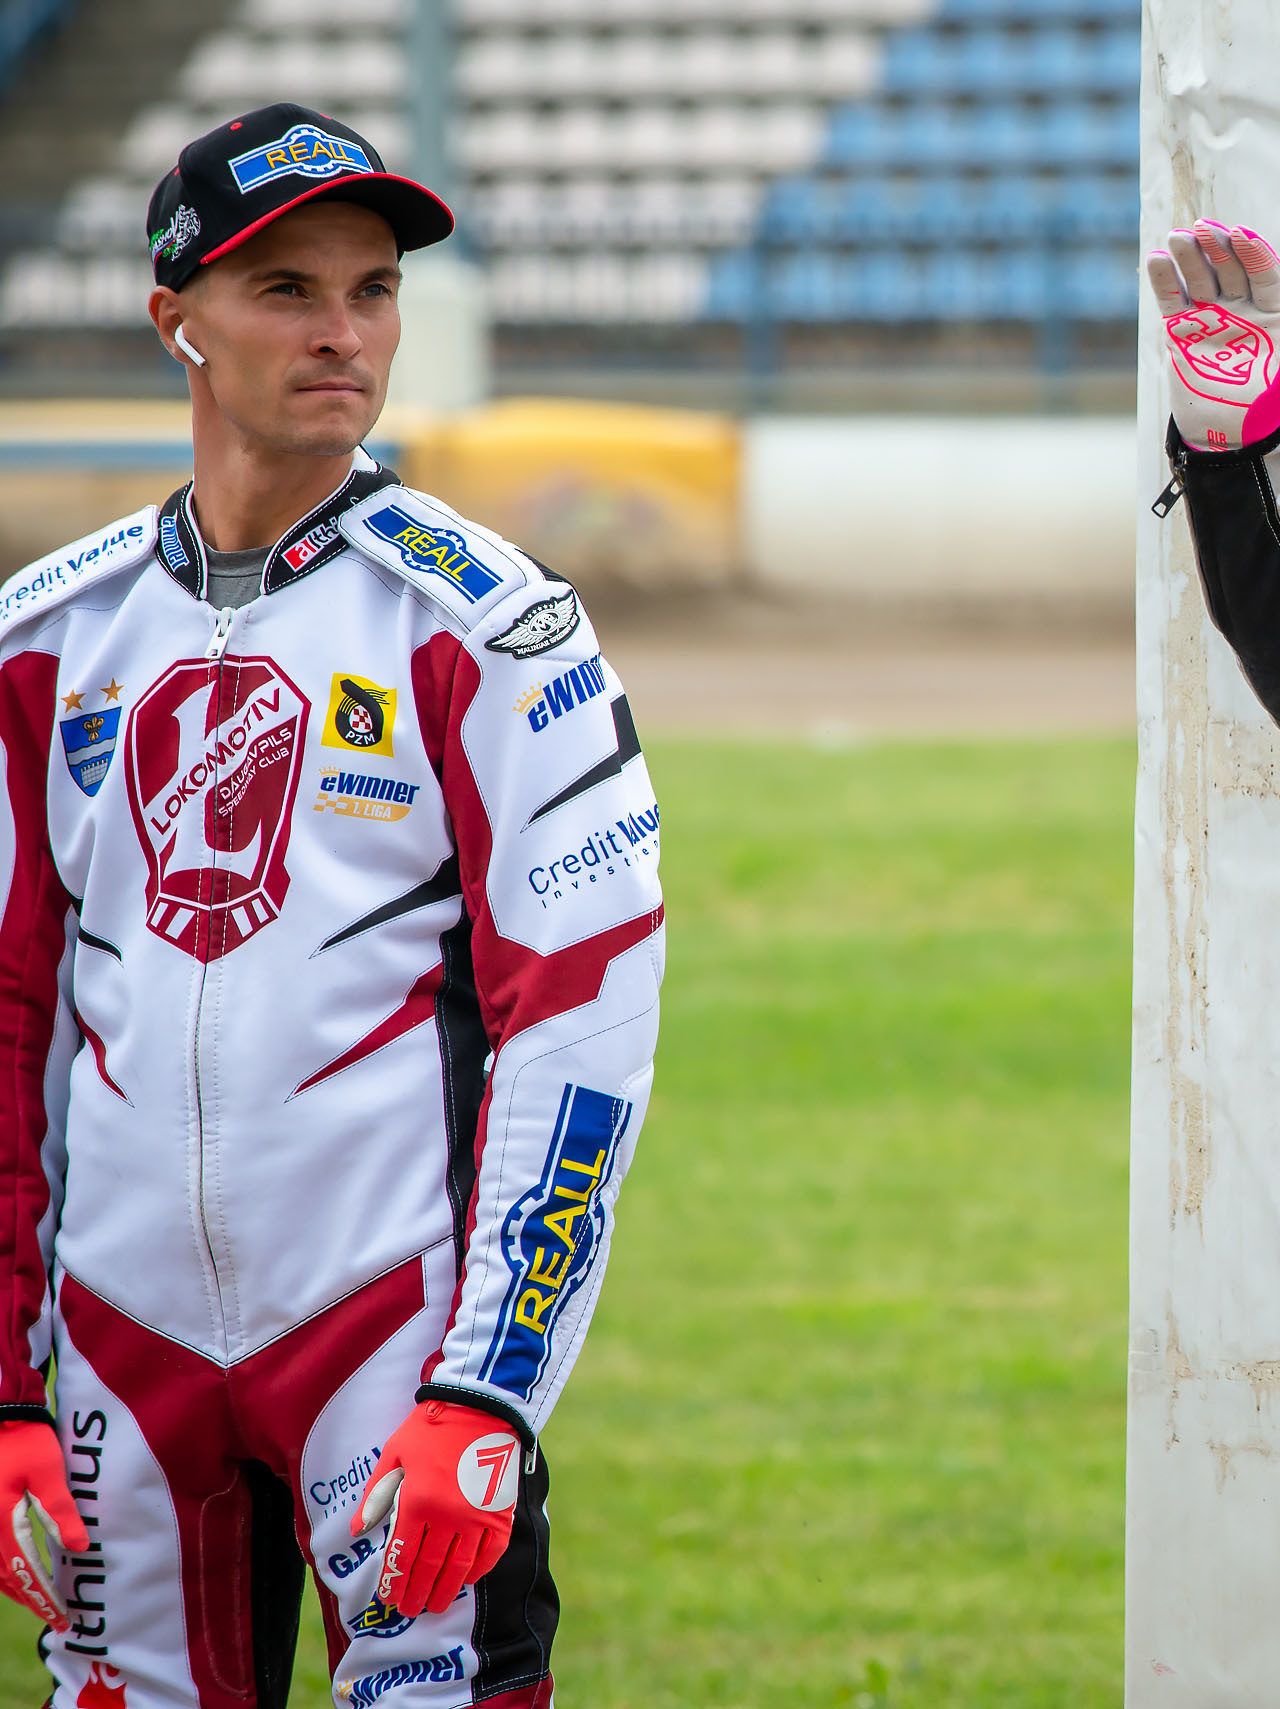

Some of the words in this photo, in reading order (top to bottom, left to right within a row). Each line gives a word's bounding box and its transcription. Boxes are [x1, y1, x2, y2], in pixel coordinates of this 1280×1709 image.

[265, 140, 354, 169] REALL
[0, 566, 63, 608] redit
[67, 525, 143, 572] Value
[393, 526, 472, 582] REALL
[150, 687, 280, 836] LOKOMOTIV
[219, 727, 293, 800] DAUGAVPILS
[258, 747, 290, 768] CLUB
[345, 730, 376, 745] PZM
[320, 771, 420, 805] eWinner
[363, 803, 392, 819] LIGA
[528, 830, 623, 895] Credit
[514, 1149, 606, 1334] REALL
[310, 1455, 373, 1506] Credit
[476, 1440, 517, 1508] 7
